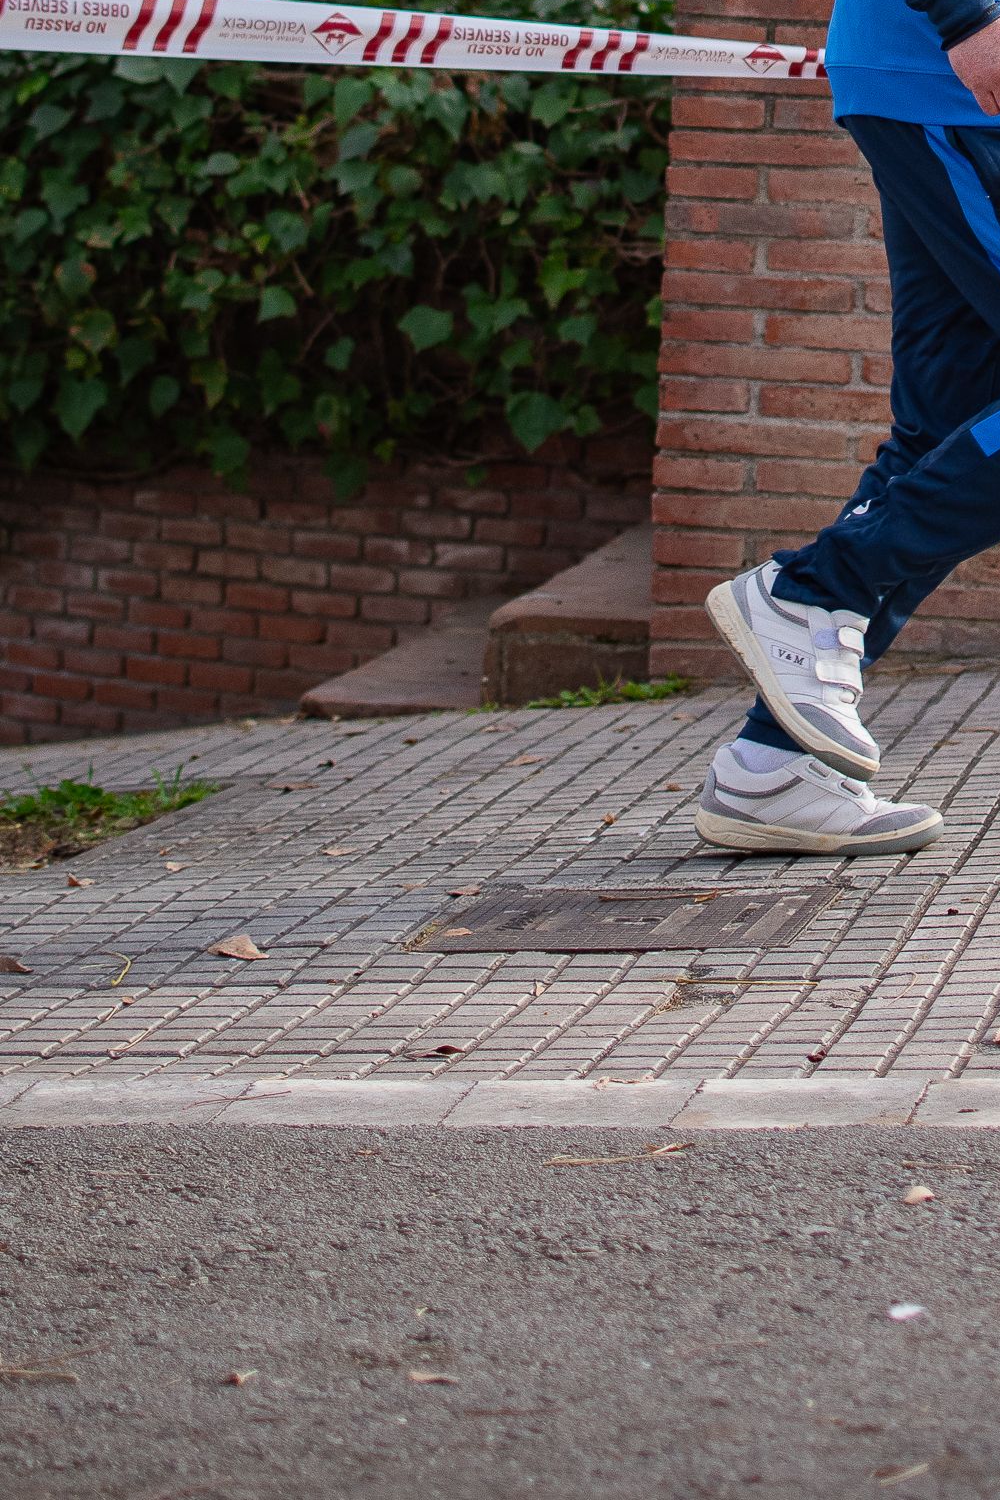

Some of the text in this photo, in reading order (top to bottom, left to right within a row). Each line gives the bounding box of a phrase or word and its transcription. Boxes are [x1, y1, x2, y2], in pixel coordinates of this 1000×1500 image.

[82, 1, 130, 19] OBRES
[24, 17, 107, 34] NO PASSEU
[222, 17, 307, 35] Valldoreix
[453, 27, 511, 43] SERVEIS
[524, 31, 569, 47] OBRES
